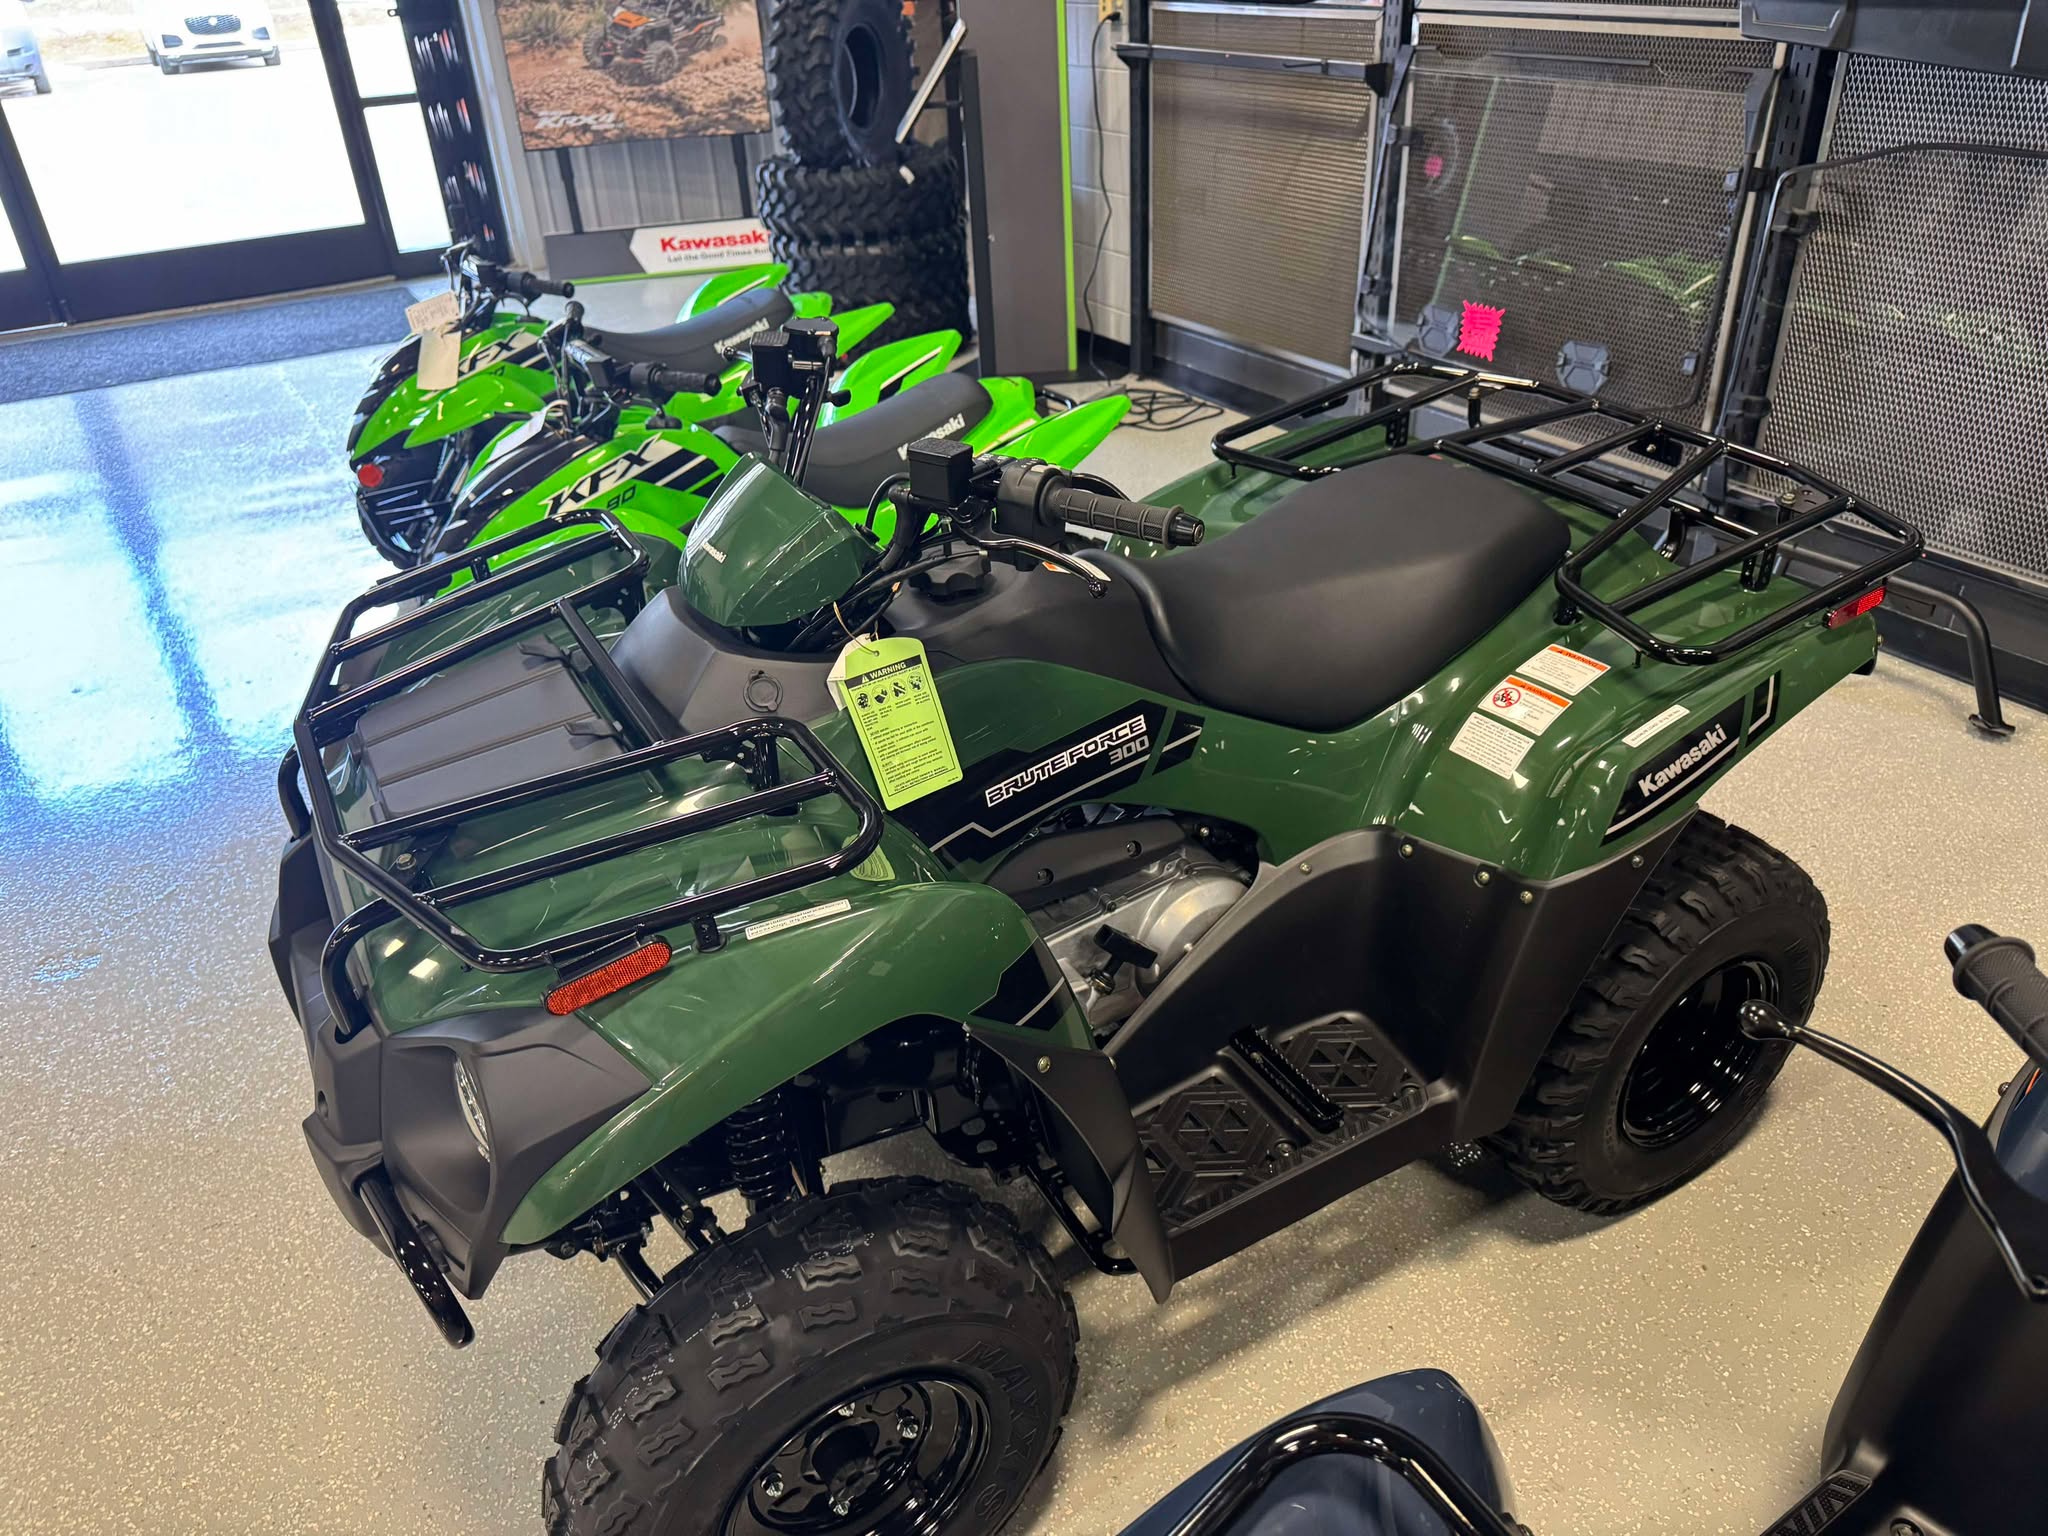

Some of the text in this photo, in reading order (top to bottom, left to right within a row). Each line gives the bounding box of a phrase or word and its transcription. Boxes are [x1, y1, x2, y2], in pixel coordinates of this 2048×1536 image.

[897, 412, 966, 461] Kasaki
[548, 437, 658, 515] KFX
[870, 662, 907, 680] WARNING
[1108, 735, 1150, 765] 300
[1638, 723, 1727, 797] Kawasaki
